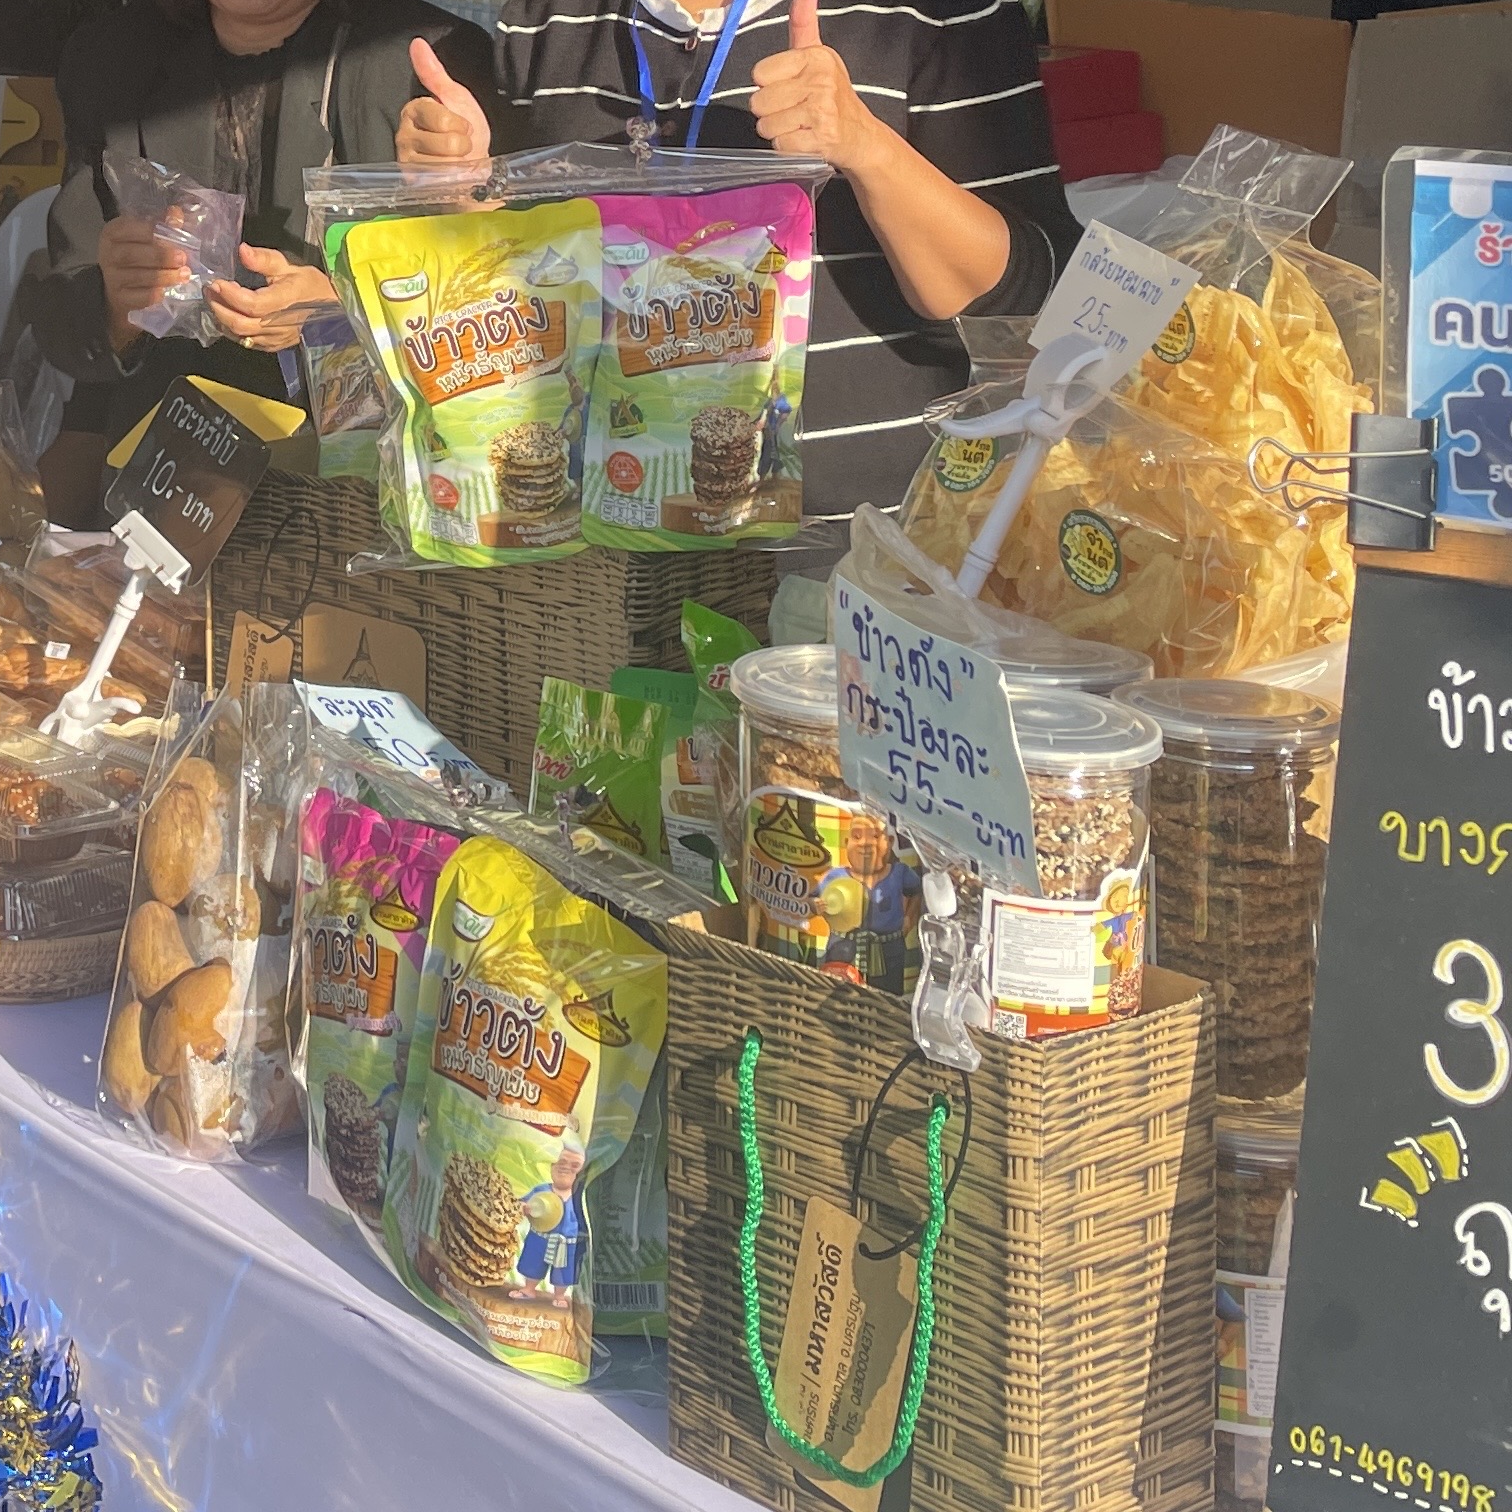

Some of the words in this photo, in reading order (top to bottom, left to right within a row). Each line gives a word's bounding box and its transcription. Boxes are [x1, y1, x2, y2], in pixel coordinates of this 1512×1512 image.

[405, 288, 549, 372] ข้าวตัง
[434, 312, 454, 326] RICE
[455, 301, 493, 320] CRACKER
[623, 274, 760, 340] ข้าวตัง
[436, 342, 546, 394] หน้าธัญพืช
[182, 492, 214, 533] บาท
[972, 811, 1026, 860] บาท
[439, 958, 566, 1078] ข้าวตัง
[441, 1041, 541, 1104] หน้าธัญพืช
[804, 1232, 843, 1375] มหาสวัสดิ์
[850, 1321, 877, 1404] 0830004371
[1289, 1424, 1496, 1512] 061-4969198
